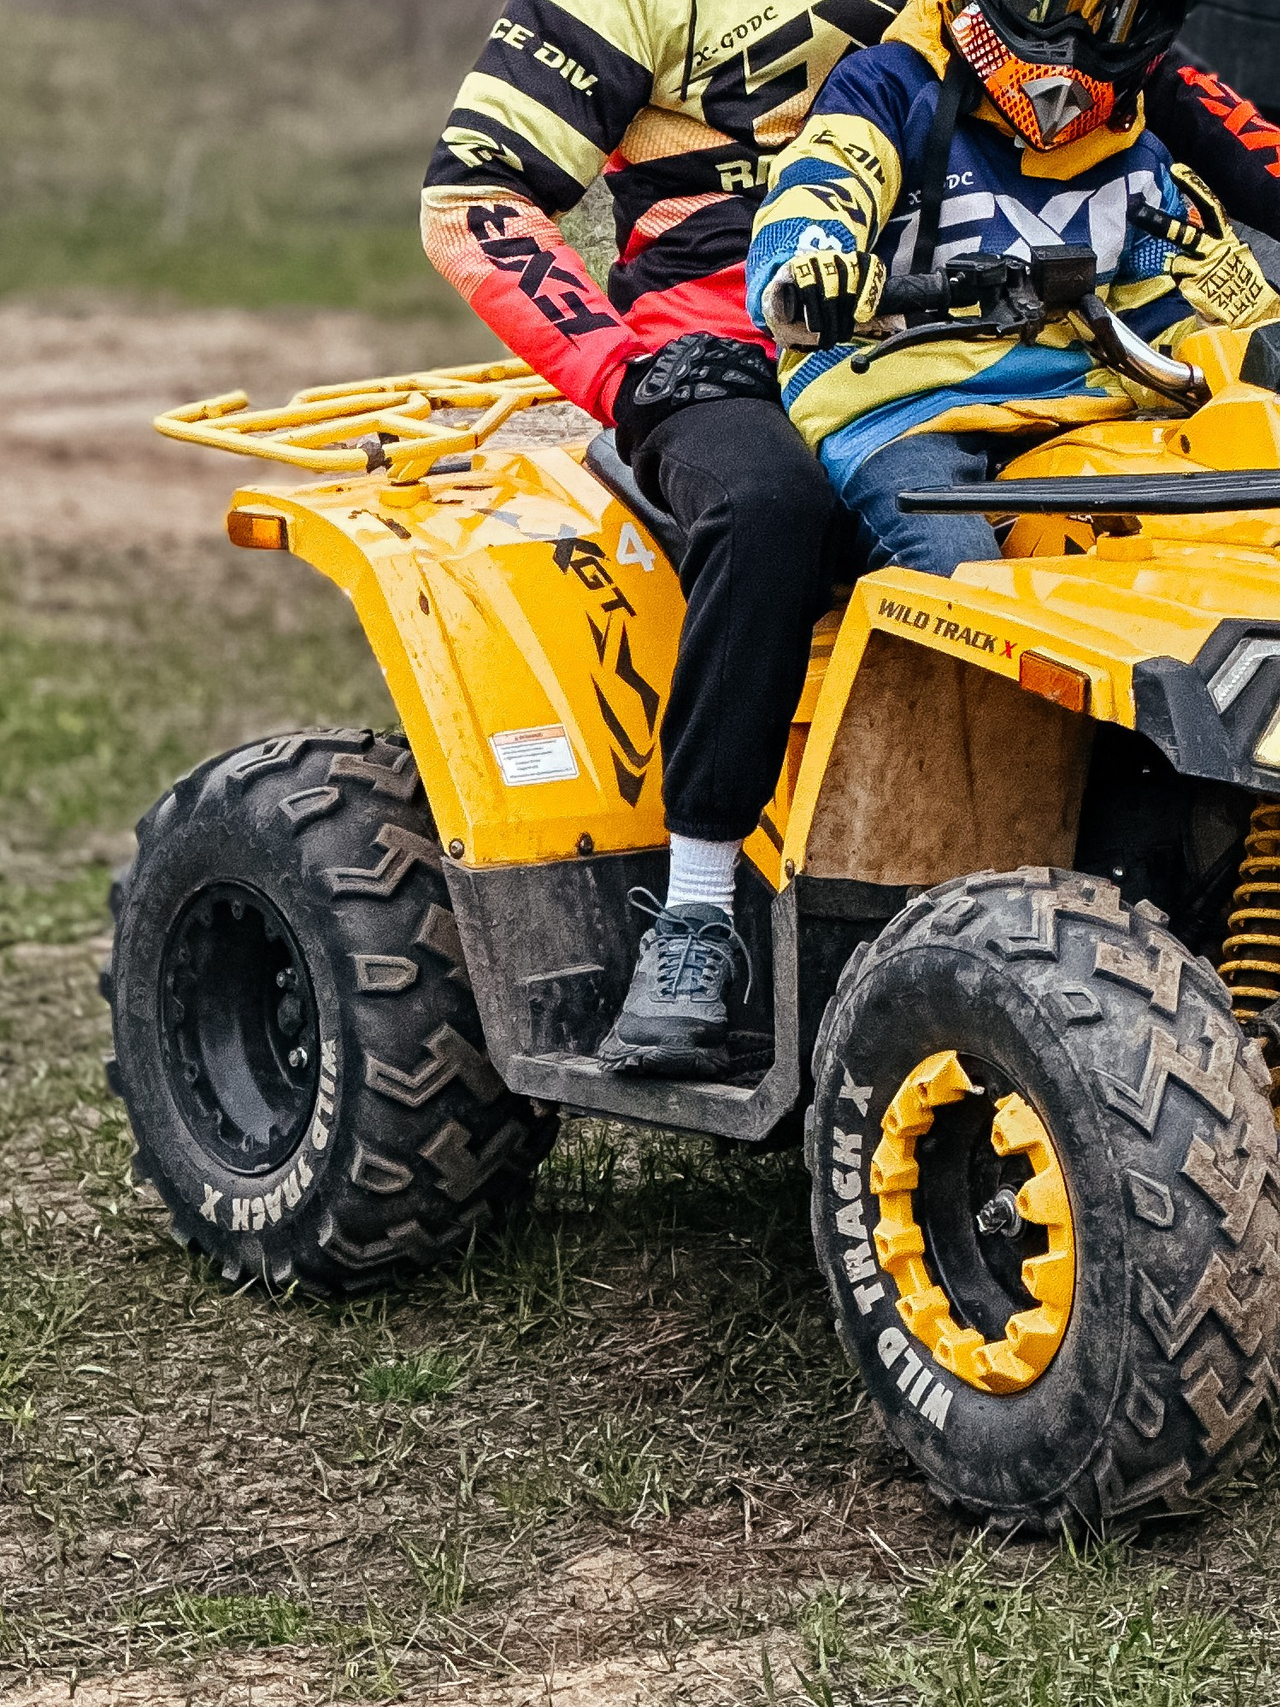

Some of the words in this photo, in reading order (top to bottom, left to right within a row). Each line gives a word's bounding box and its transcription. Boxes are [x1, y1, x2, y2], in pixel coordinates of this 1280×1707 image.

[533, 41, 599, 97] DIV.
[616, 522, 656, 572] 4
[877, 597, 931, 630] WILD
[932, 617, 999, 654] TRACK
[999, 639, 1019, 660] X
[836, 1056, 874, 1118] X
[200, 1182, 224, 1224] X
[232, 1155, 314, 1231] TRACK
[832, 1125, 886, 1316] TRACK
[878, 1326, 953, 1431] WILD
